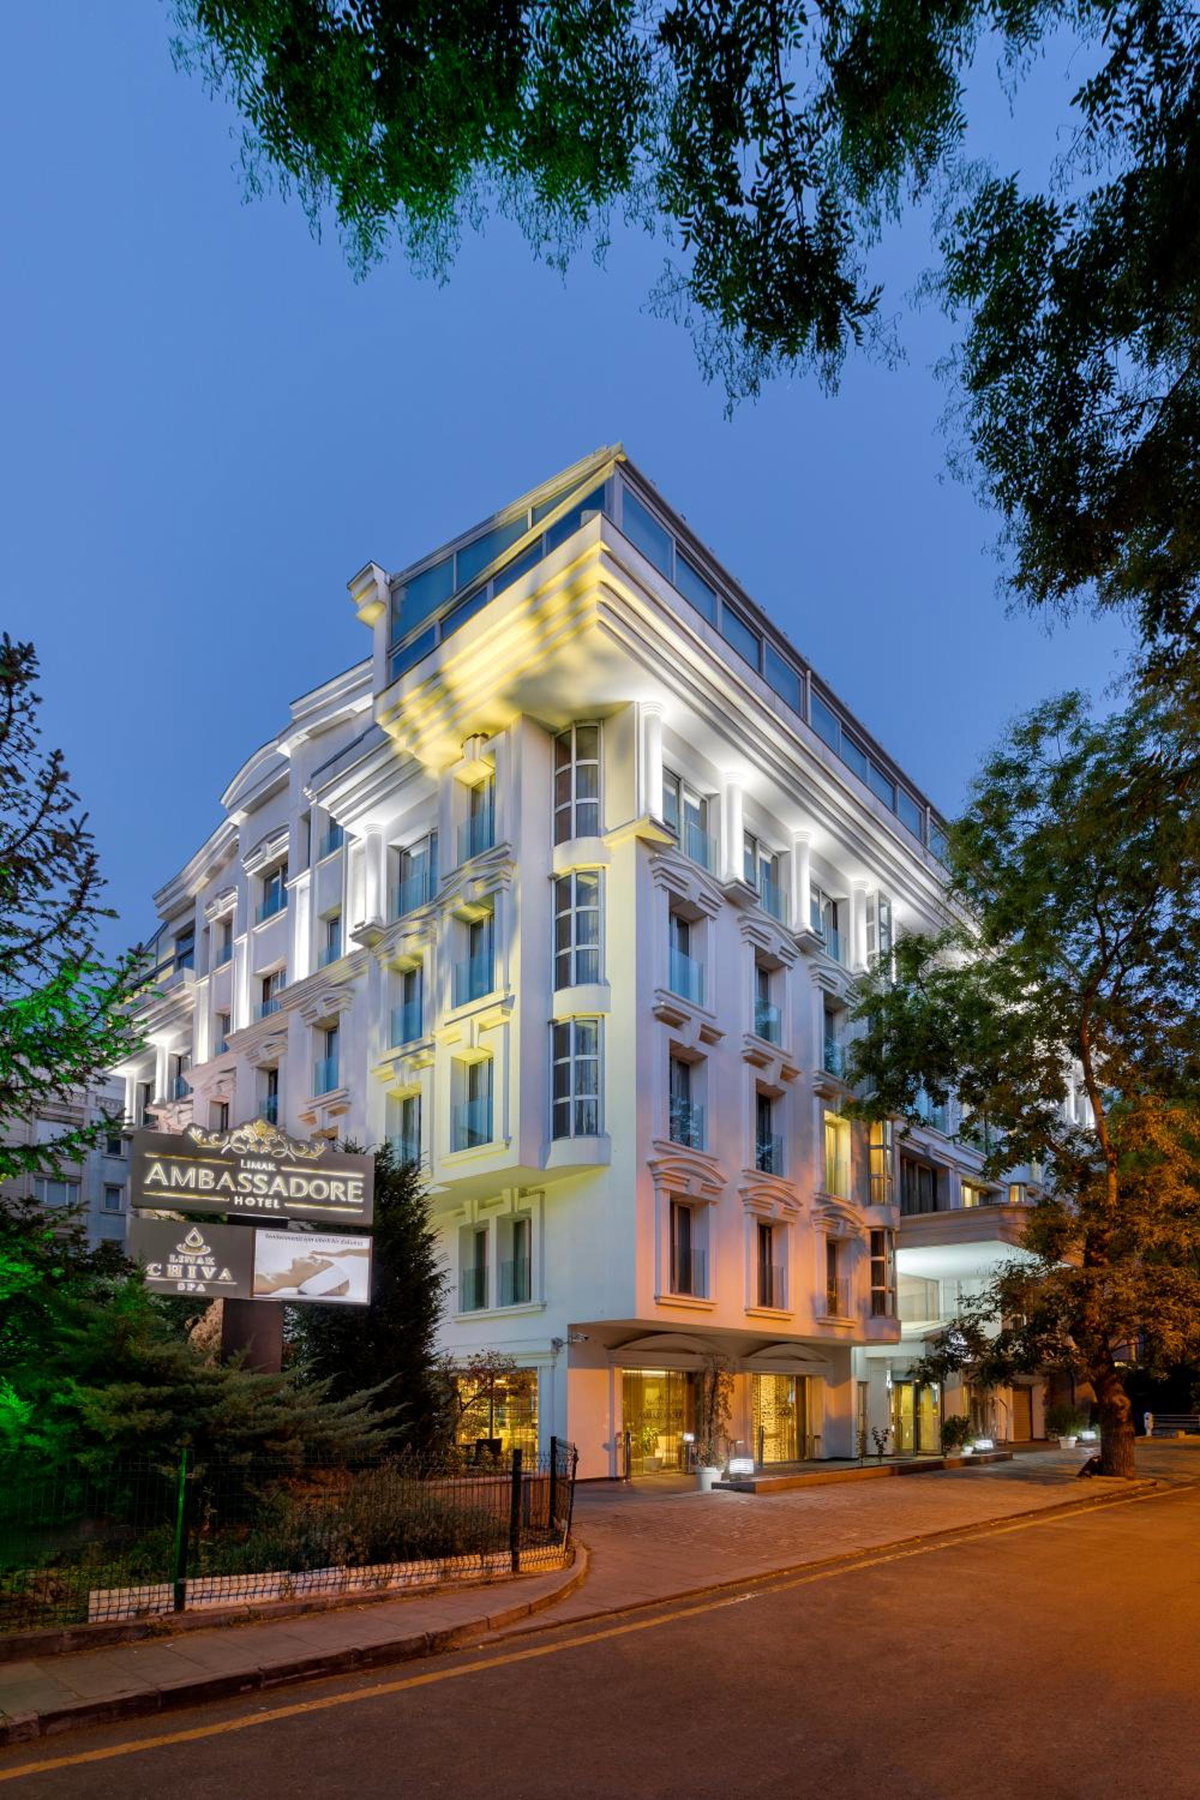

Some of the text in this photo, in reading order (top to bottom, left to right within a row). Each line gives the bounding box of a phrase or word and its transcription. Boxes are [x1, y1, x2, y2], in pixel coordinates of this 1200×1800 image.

[240, 1159, 277, 1172] LIMAK
[143, 1162, 364, 1204] AMBASSADORE
[234, 1195, 280, 1209] HOTEL
[145, 1262, 233, 1281] CHIVA
[177, 1281, 206, 1292] SPA
